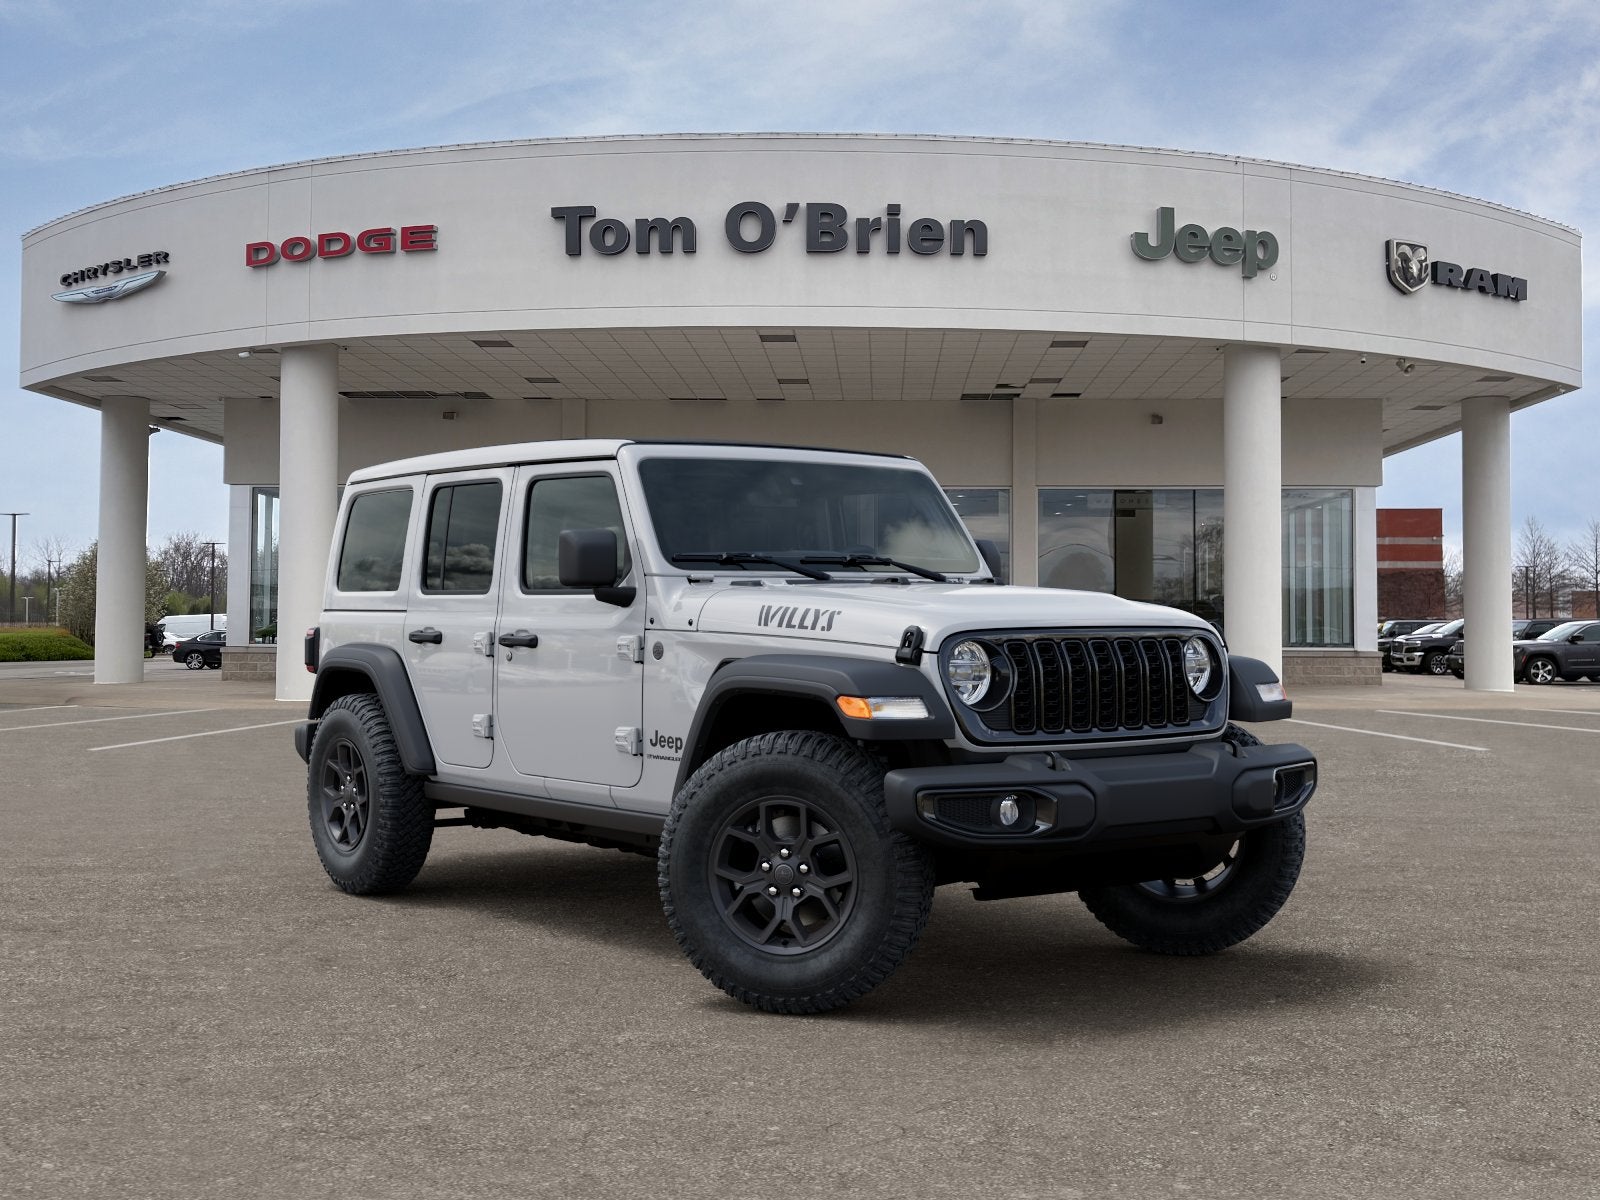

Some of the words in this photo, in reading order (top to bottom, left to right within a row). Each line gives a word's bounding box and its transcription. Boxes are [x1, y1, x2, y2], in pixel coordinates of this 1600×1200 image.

[245, 225, 439, 268] DODGE
[551, 205, 697, 256] Tom
[725, 201, 989, 256] O'Brien
[1130, 206, 1279, 279] Jeep
[60, 251, 170, 287] CHRYSLER
[1430, 260, 1528, 302] RAM
[758, 604, 842, 632] WILLYS
[649, 730, 683, 753] Jeep
